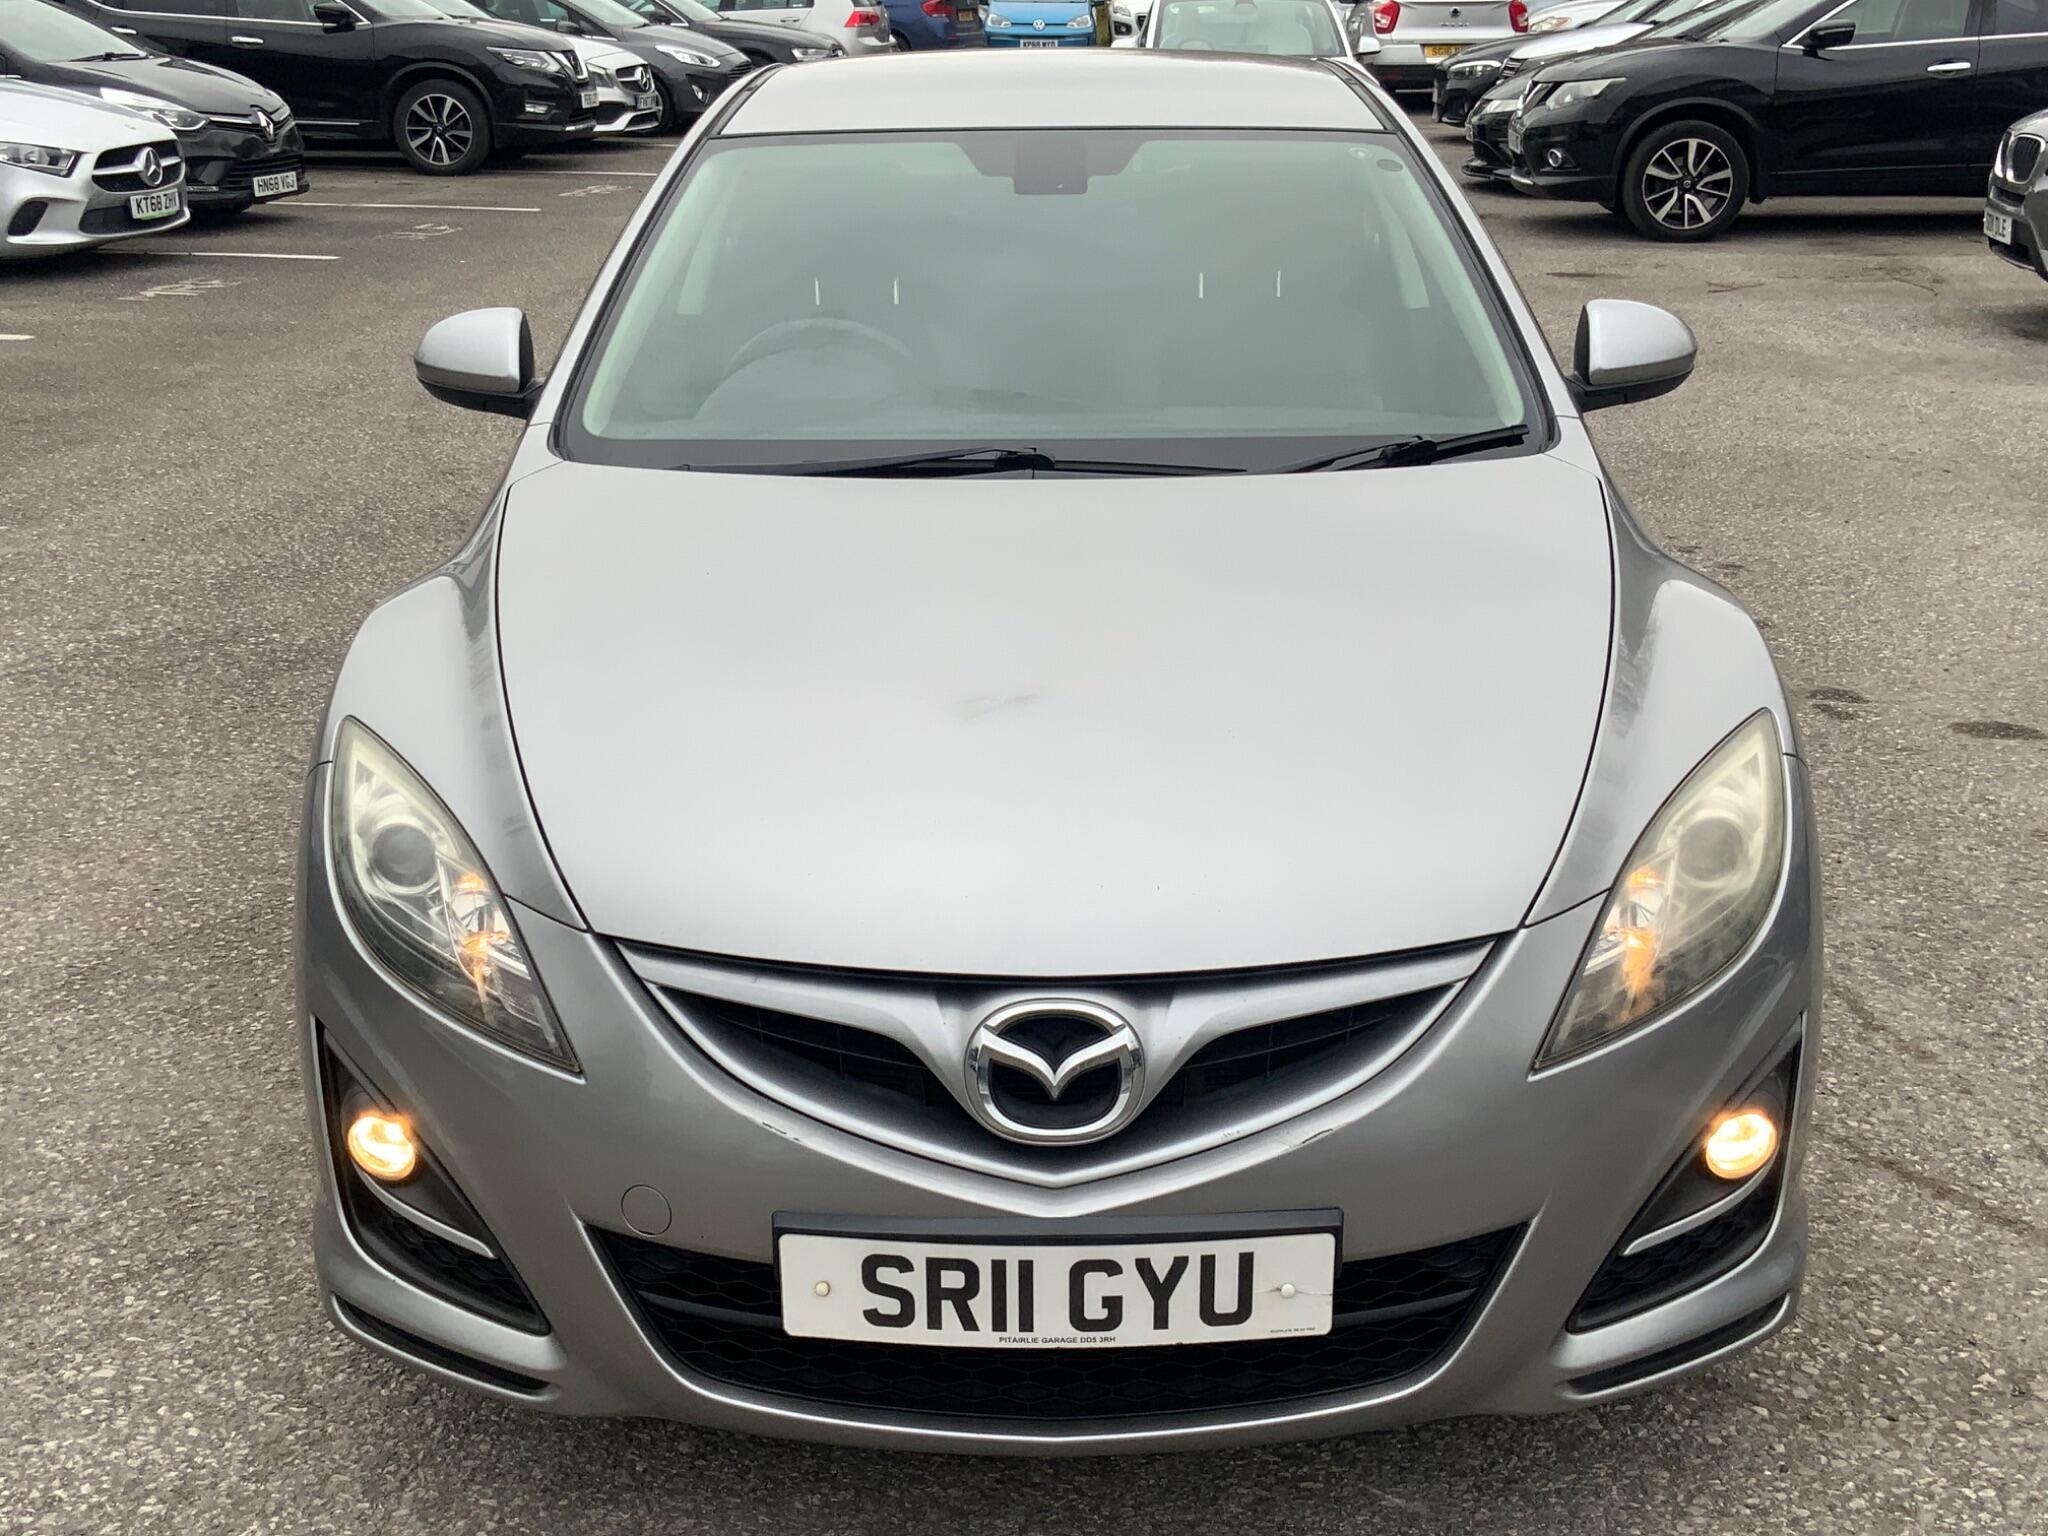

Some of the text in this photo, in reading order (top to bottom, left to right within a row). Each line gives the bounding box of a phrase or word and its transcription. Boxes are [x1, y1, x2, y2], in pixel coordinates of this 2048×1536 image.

[135, 194, 162, 215] KT68
[861, 1251, 1255, 1333] SR11 GYU
[998, 1336, 1039, 1344] PITAIRLIE
[1041, 1336, 1078, 1344] GARAGE
[1079, 1336, 1097, 1344] DD5
